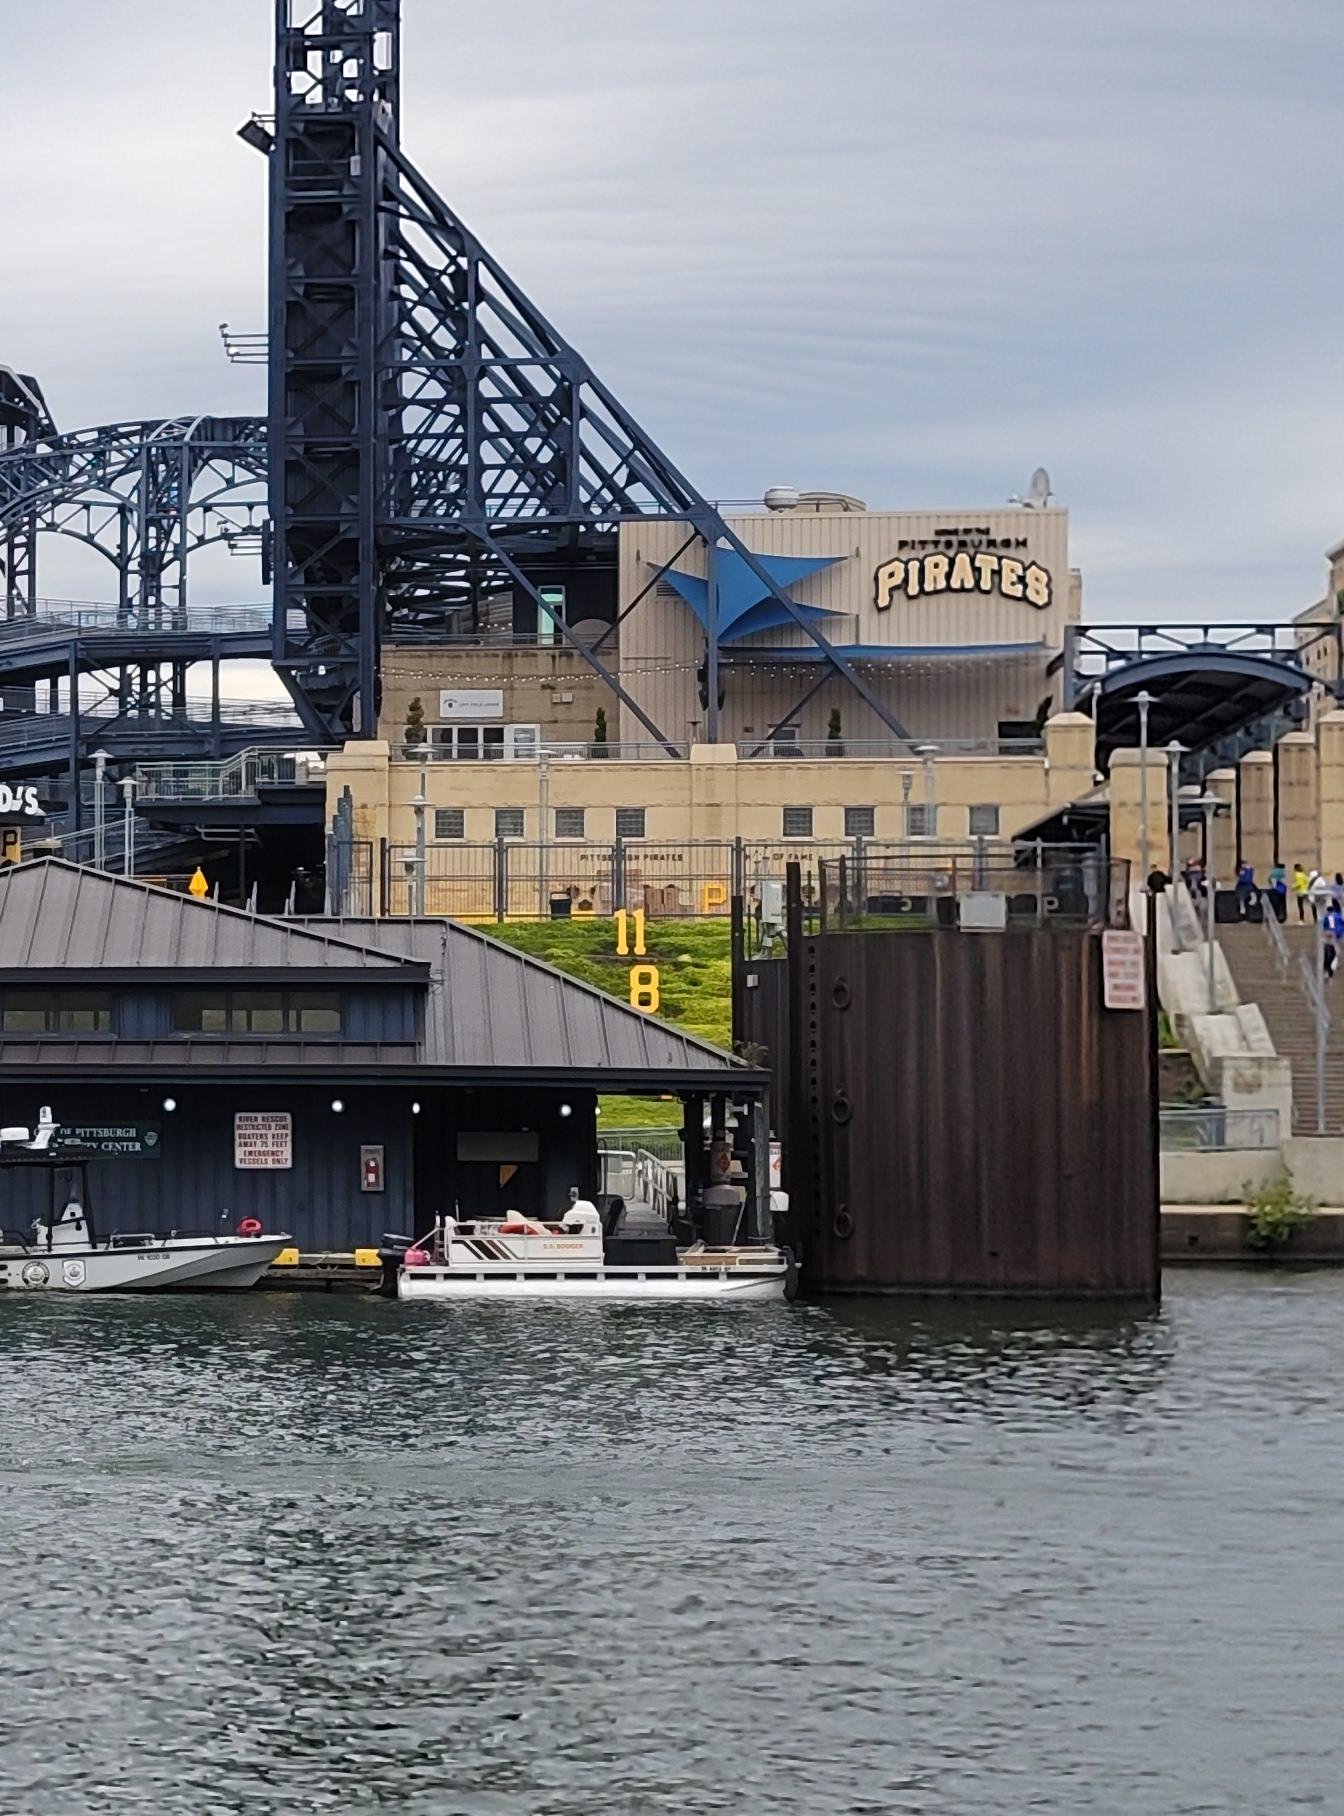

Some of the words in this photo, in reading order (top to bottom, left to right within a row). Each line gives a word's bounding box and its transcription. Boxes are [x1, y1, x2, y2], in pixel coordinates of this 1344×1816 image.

[897, 537, 1028, 550] PITTSBURGH
[874, 551, 1053, 612] PIRATES
[1, 829, 18, 857] P
[580, 854, 639, 862] PITTSBGH
[644, 854, 684, 862] PIRATES
[772, 853, 785, 861] OF
[788, 853, 814, 861] FAME
[701, 881, 729, 915] P
[614, 908, 647, 956] 11
[629, 964, 660, 1014] 8
[75, 1127, 137, 1138] PITTSBURGH
[101, 1141, 142, 1152] CENTER
